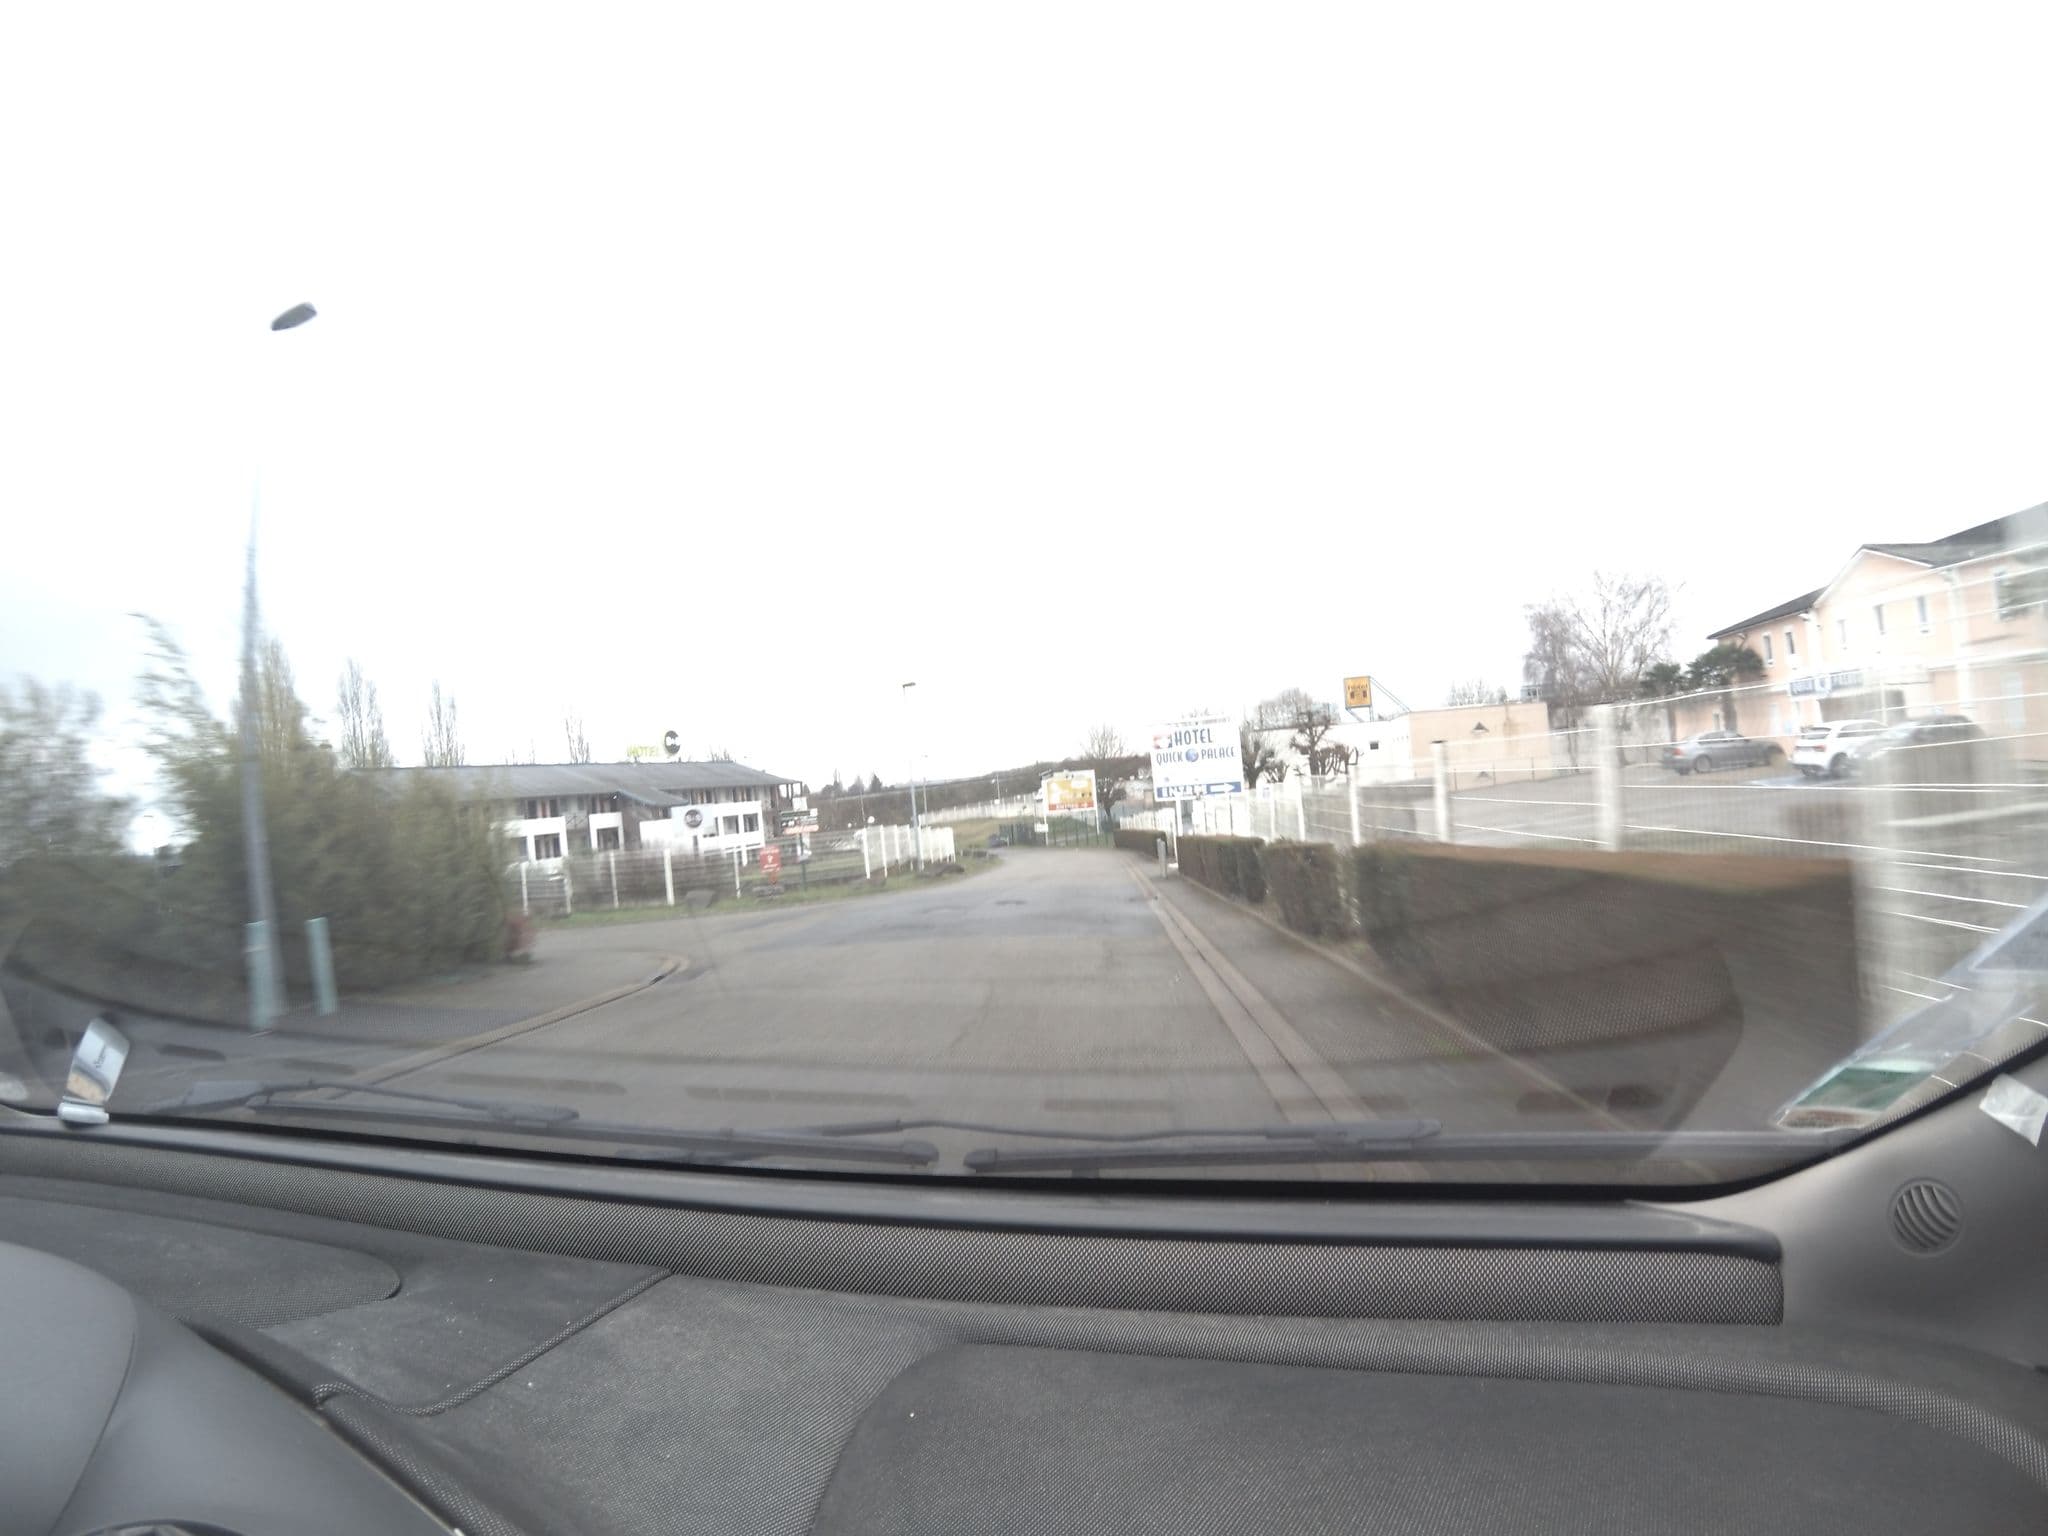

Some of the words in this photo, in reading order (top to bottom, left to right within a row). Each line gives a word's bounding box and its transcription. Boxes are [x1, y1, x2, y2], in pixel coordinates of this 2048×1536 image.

[1174, 727, 1214, 746] HOTEL
[1156, 750, 1184, 766] QUICK
[1200, 746, 1236, 760] PALACE
